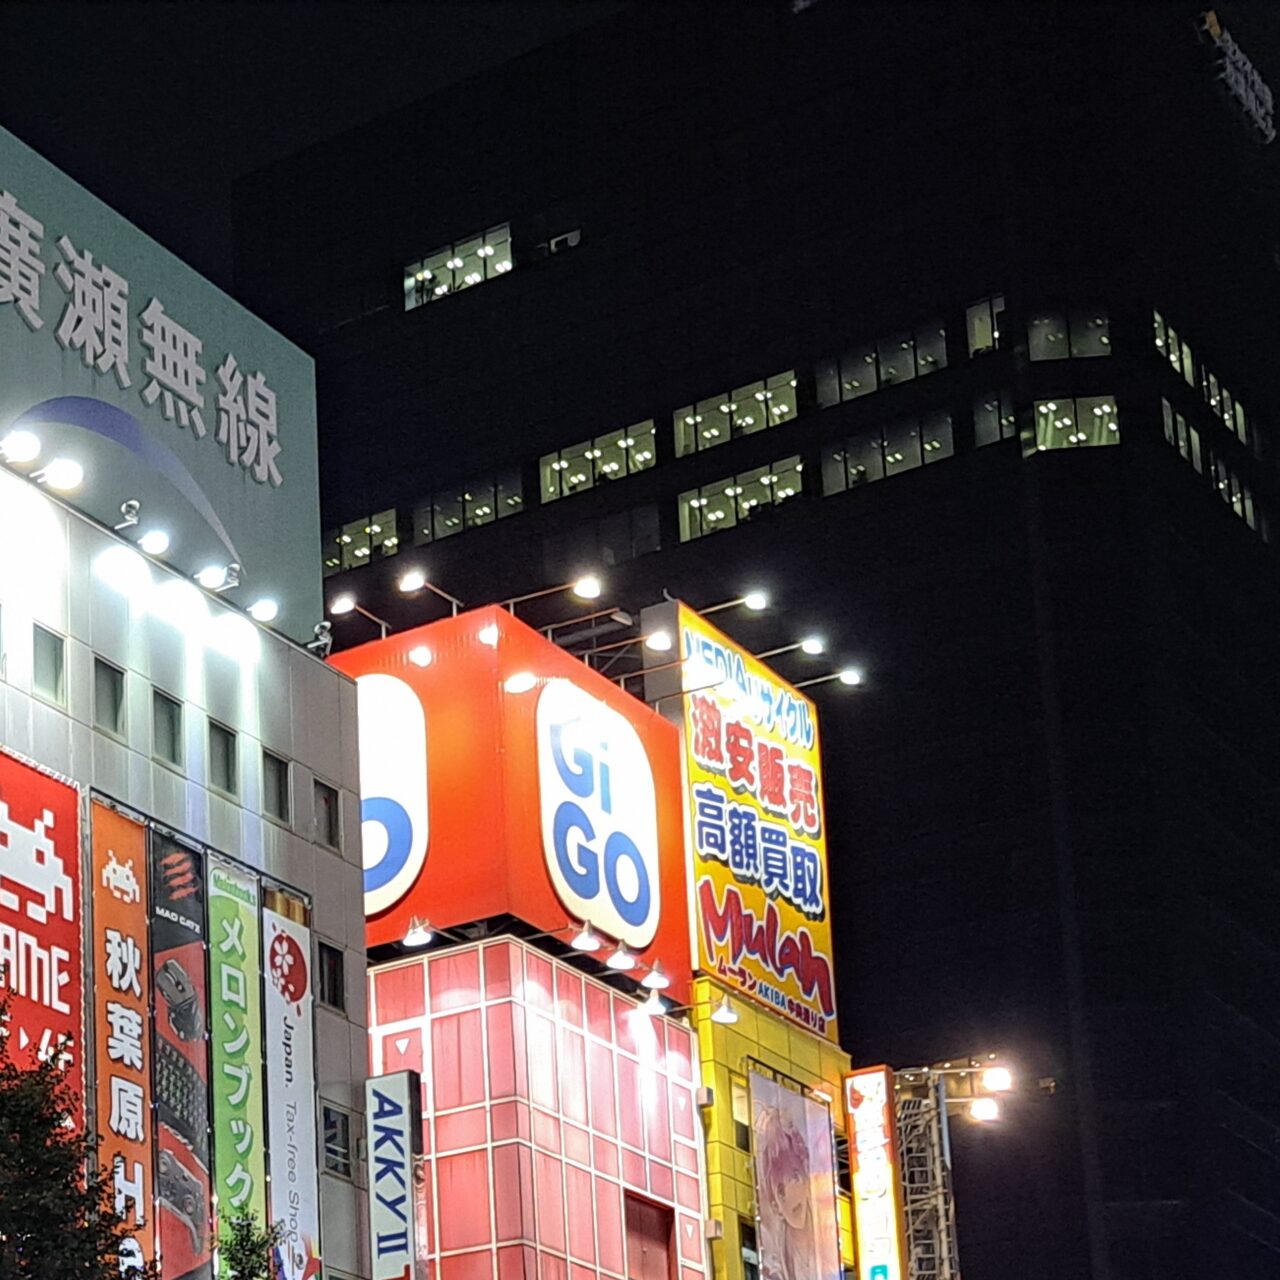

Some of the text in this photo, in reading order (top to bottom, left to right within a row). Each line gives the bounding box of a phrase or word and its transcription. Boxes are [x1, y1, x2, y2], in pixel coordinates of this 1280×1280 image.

[691, 693, 817, 829] 激安販売
[696, 787, 821, 908] 高額買取
[699, 879, 834, 1016] Mulan
[717, 955, 757, 991] ムーラン
[220, 917, 254, 1208] メロンブック
[284, 1101, 298, 1184] Tax-free
[371, 1087, 408, 1225] AKKY
[287, 1190, 301, 1243] Shop
